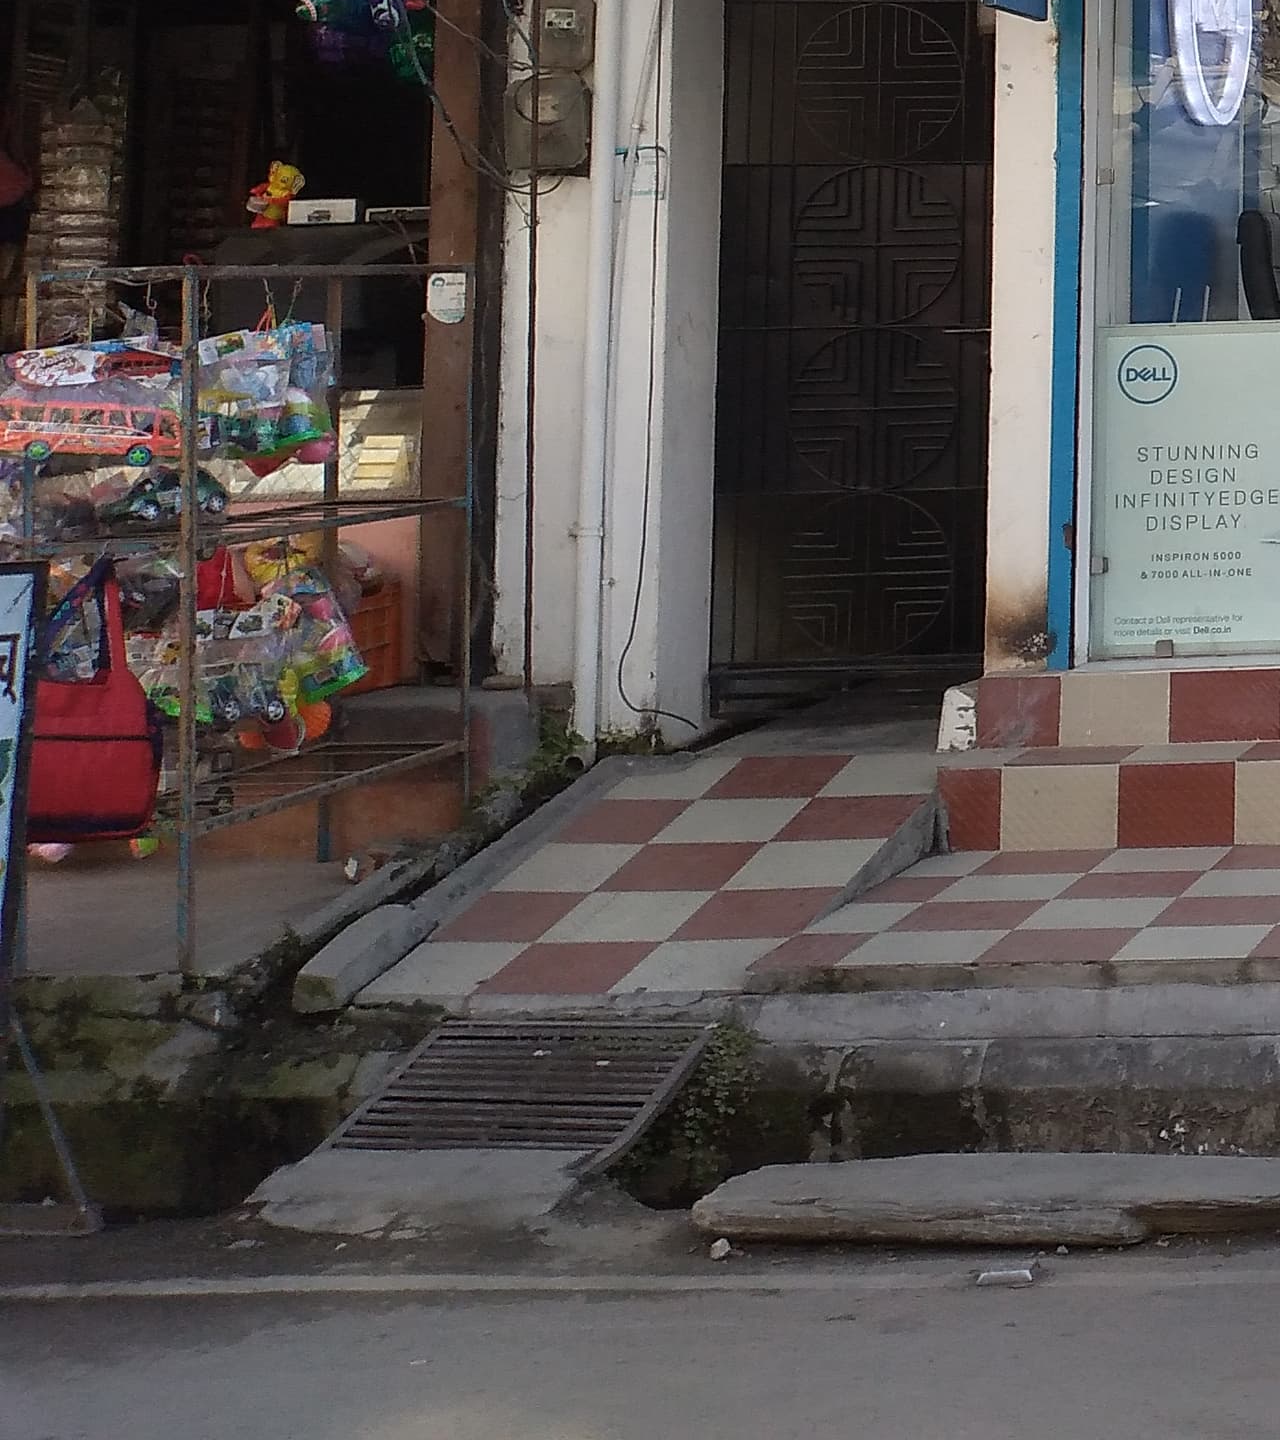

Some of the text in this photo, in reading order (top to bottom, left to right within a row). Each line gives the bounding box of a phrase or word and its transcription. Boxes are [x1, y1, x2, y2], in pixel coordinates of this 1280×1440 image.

[1125, 365, 1172, 383] DELL
[1137, 444, 1260, 463] STUNNING
[1150, 467, 1237, 486] DESIGN
[1114, 488, 1280, 509] INFINITYEDGE
[1151, 551, 1242, 563] INSPIRON 5000
[1140, 568, 1253, 580] & 7000 ALL-IN-ONE
